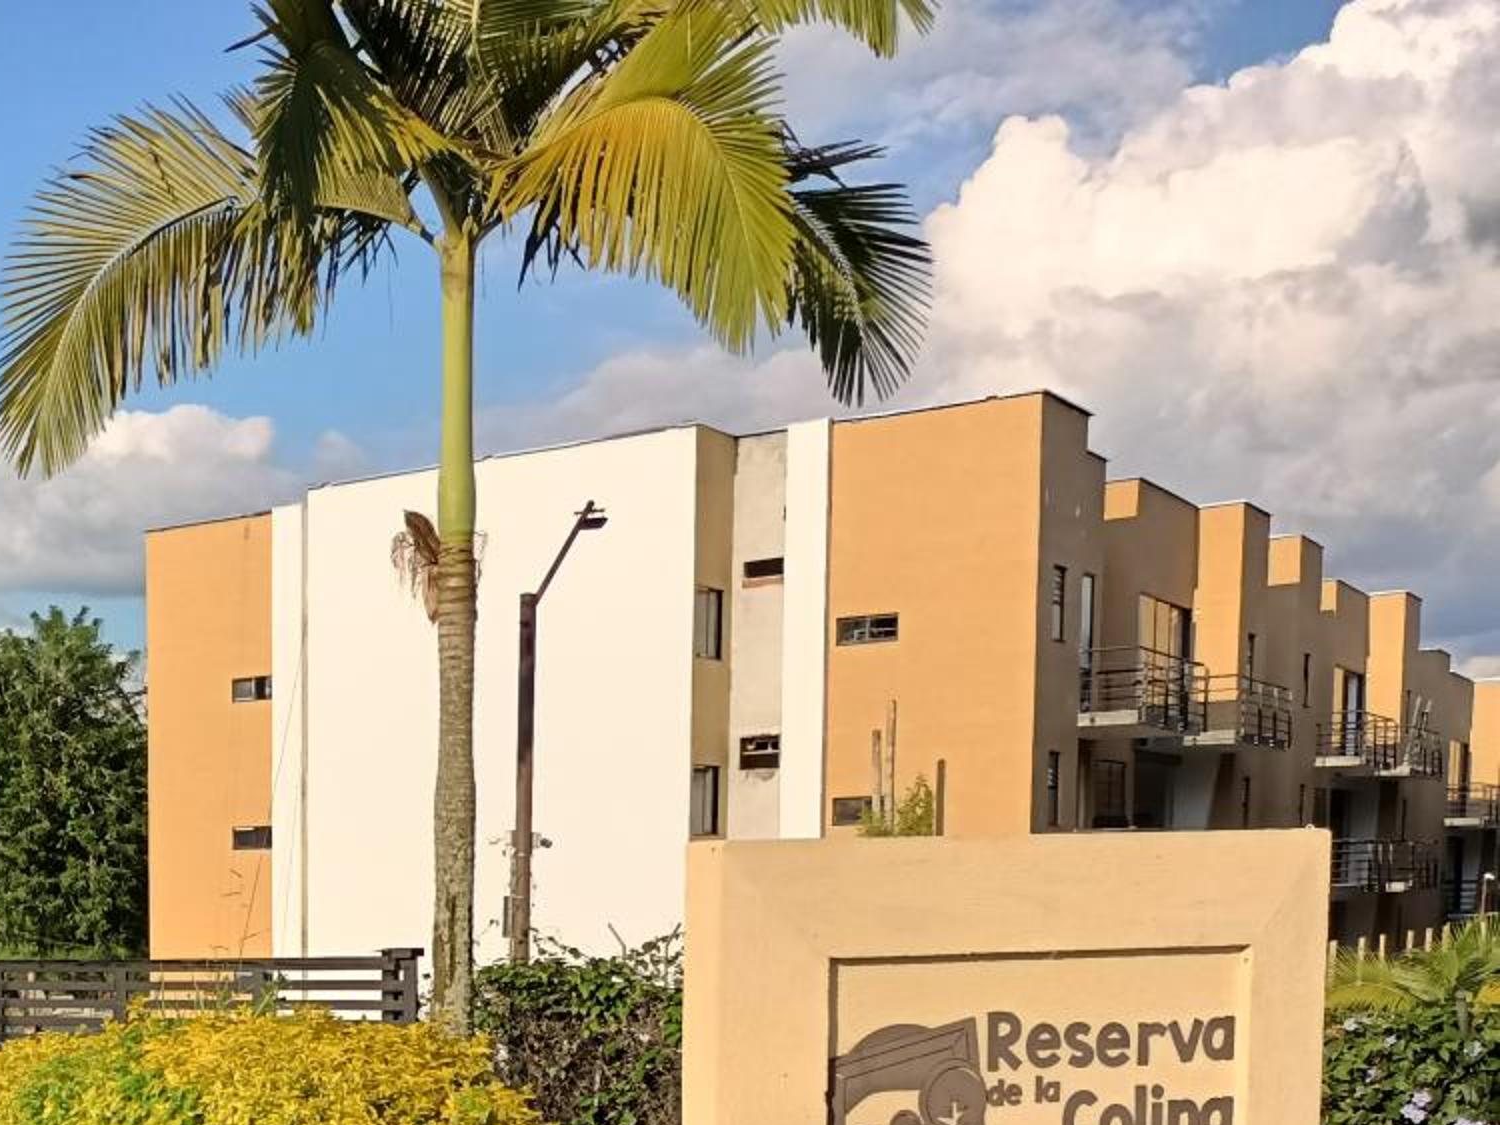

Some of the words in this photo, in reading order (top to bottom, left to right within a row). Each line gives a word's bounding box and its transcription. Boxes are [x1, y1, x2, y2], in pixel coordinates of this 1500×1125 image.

[987, 1011, 1235, 1072] Reserva
[987, 1078, 1023, 1107] de
[1035, 1075, 1061, 1104] la
